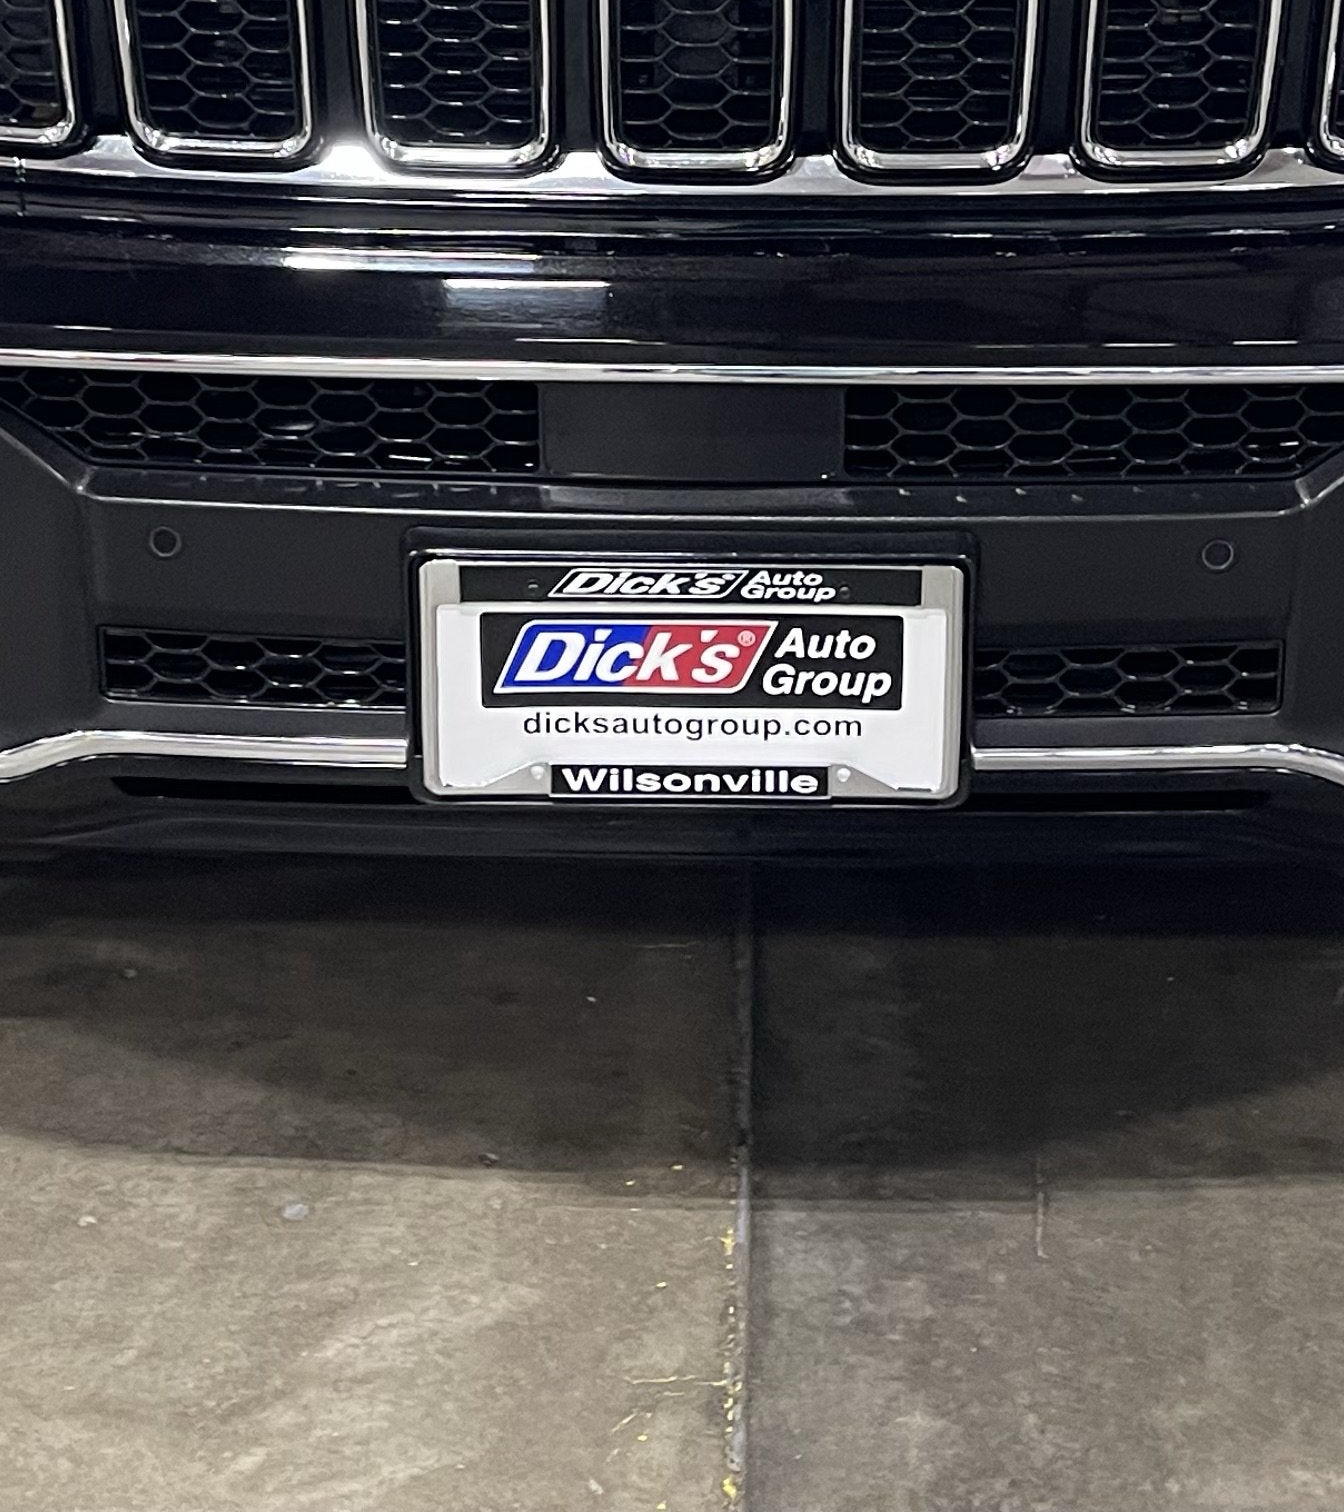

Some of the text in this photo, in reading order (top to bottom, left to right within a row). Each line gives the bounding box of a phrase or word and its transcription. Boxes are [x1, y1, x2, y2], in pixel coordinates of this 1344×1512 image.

[562, 572, 727, 595] Dick's
[748, 570, 823, 586] Auto
[740, 585, 836, 602] Group
[513, 628, 740, 683] Dick's
[773, 628, 877, 660] Auto
[762, 664, 892, 704] Group
[523, 712, 862, 742] dicksautogroup.com
[561, 767, 819, 794] Wilsonville
